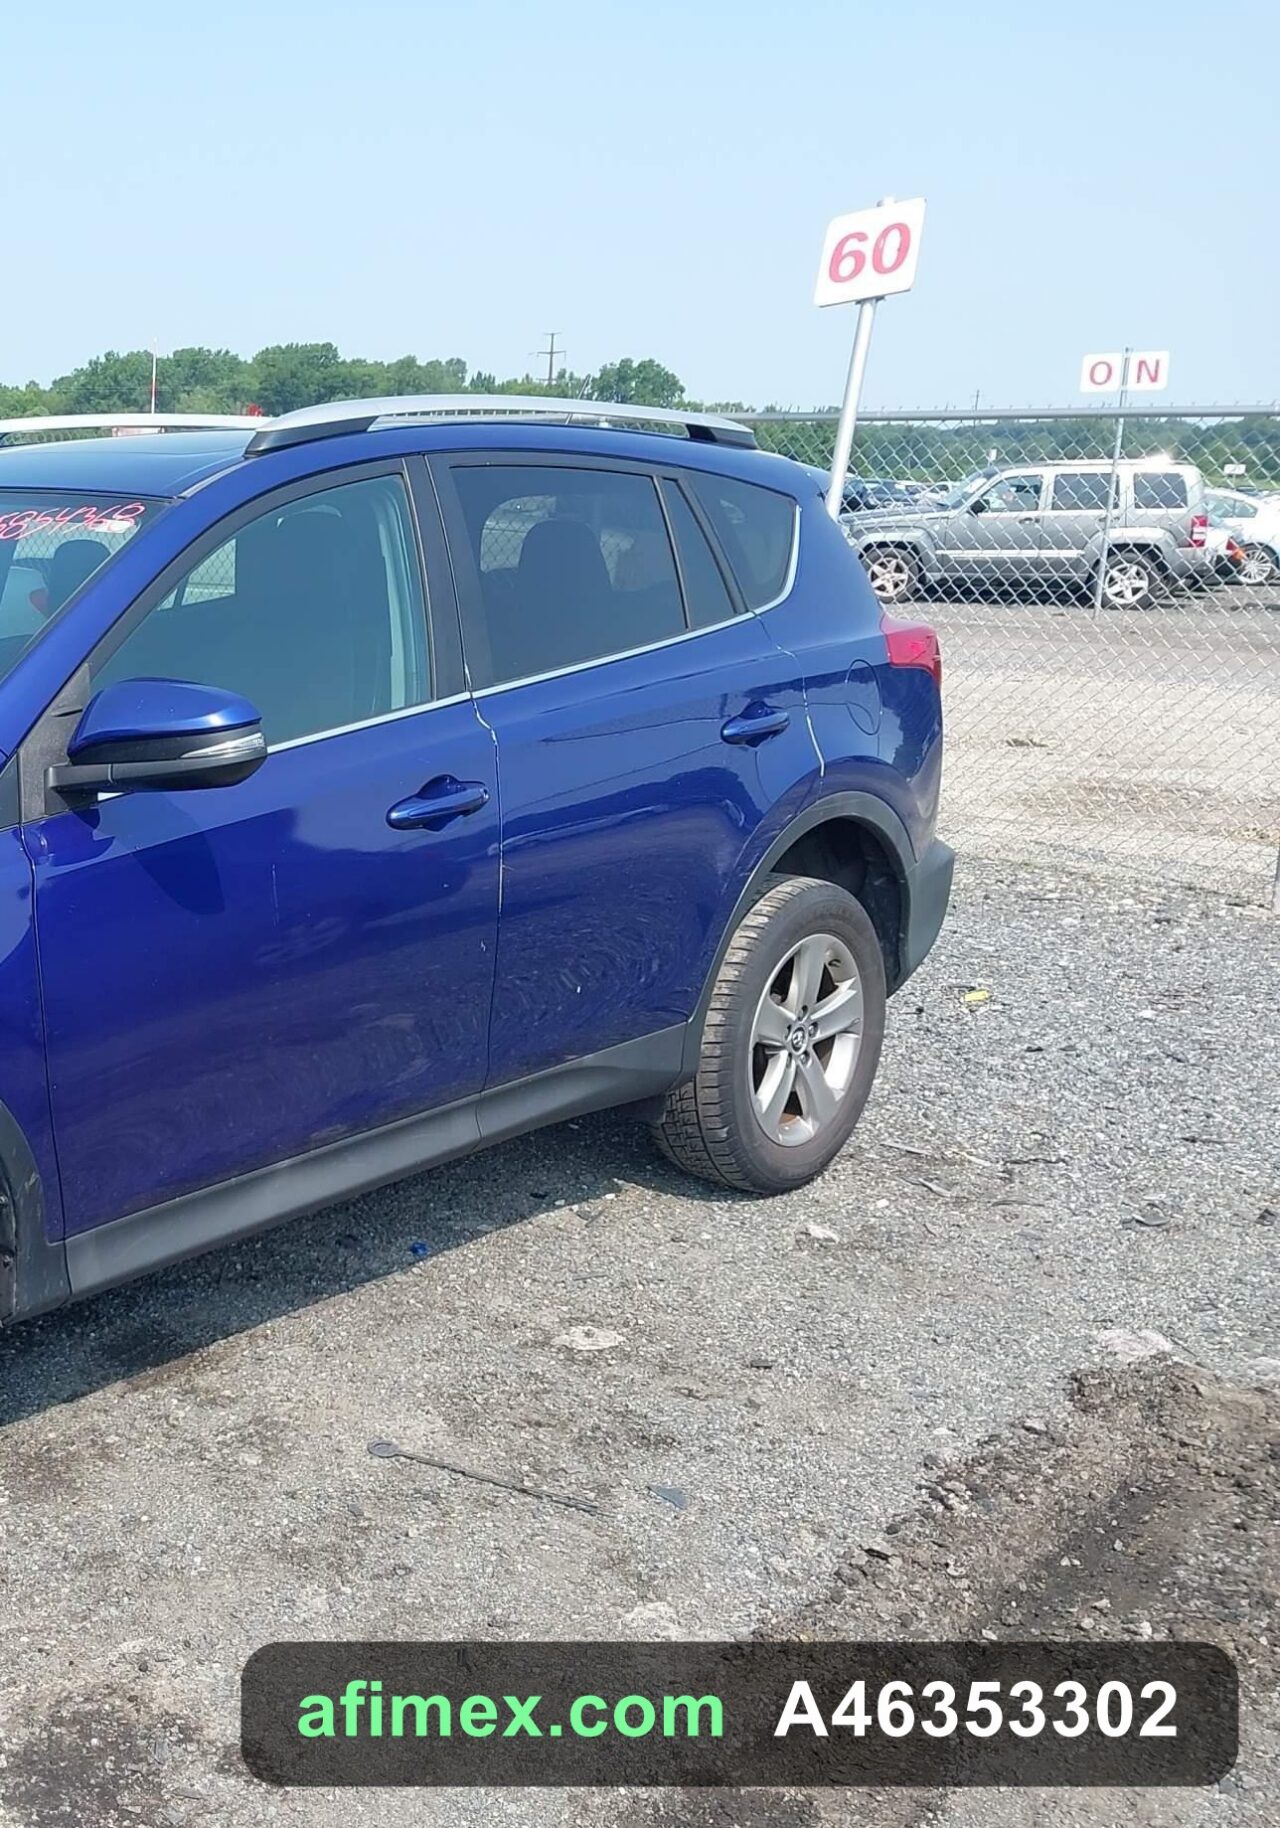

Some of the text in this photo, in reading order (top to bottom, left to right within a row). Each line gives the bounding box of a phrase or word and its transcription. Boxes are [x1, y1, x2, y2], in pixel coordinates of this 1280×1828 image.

[828, 221, 912, 284] 60
[1089, 358, 1161, 386] O N
